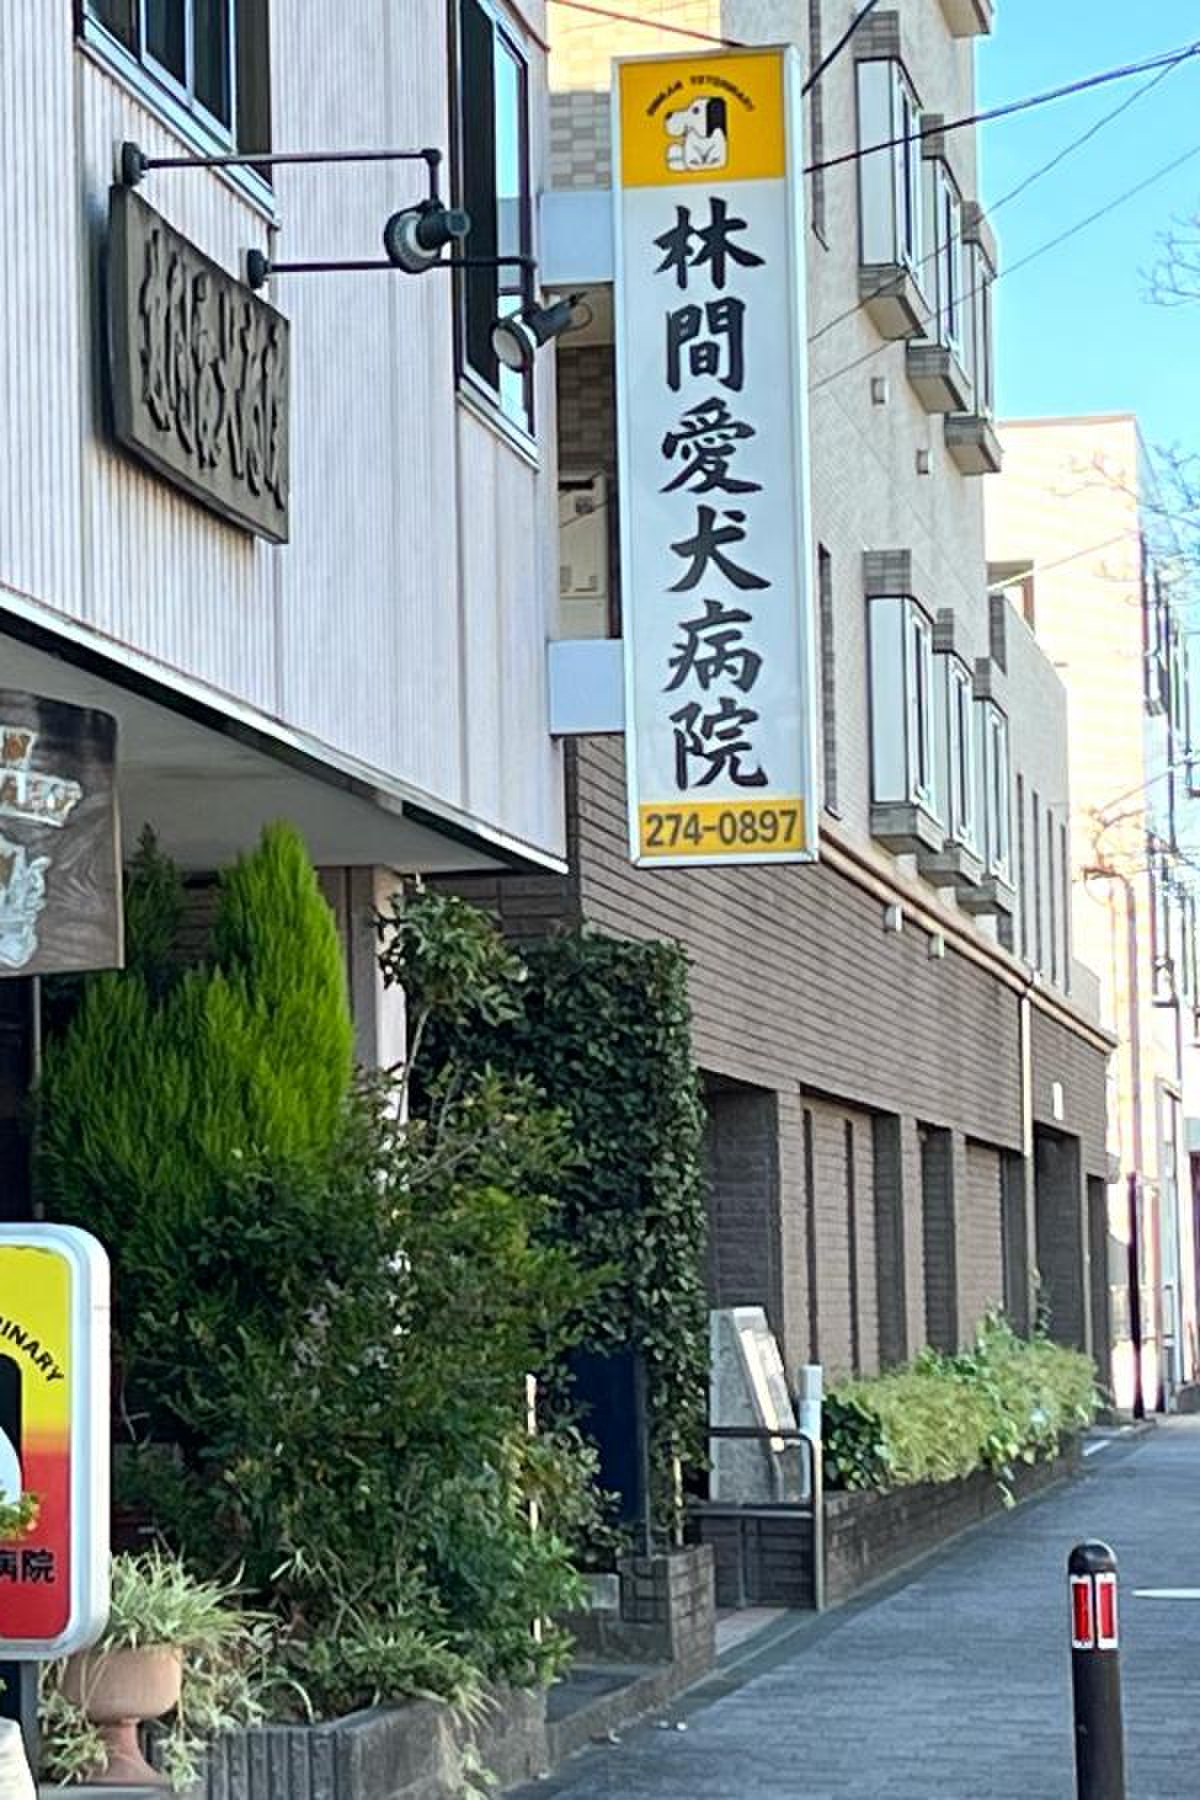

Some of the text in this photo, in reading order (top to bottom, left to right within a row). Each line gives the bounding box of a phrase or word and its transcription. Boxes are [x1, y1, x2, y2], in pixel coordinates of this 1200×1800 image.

[653, 197, 770, 791] 林間愛犬病院
[645, 809, 798, 847] 274-0897
